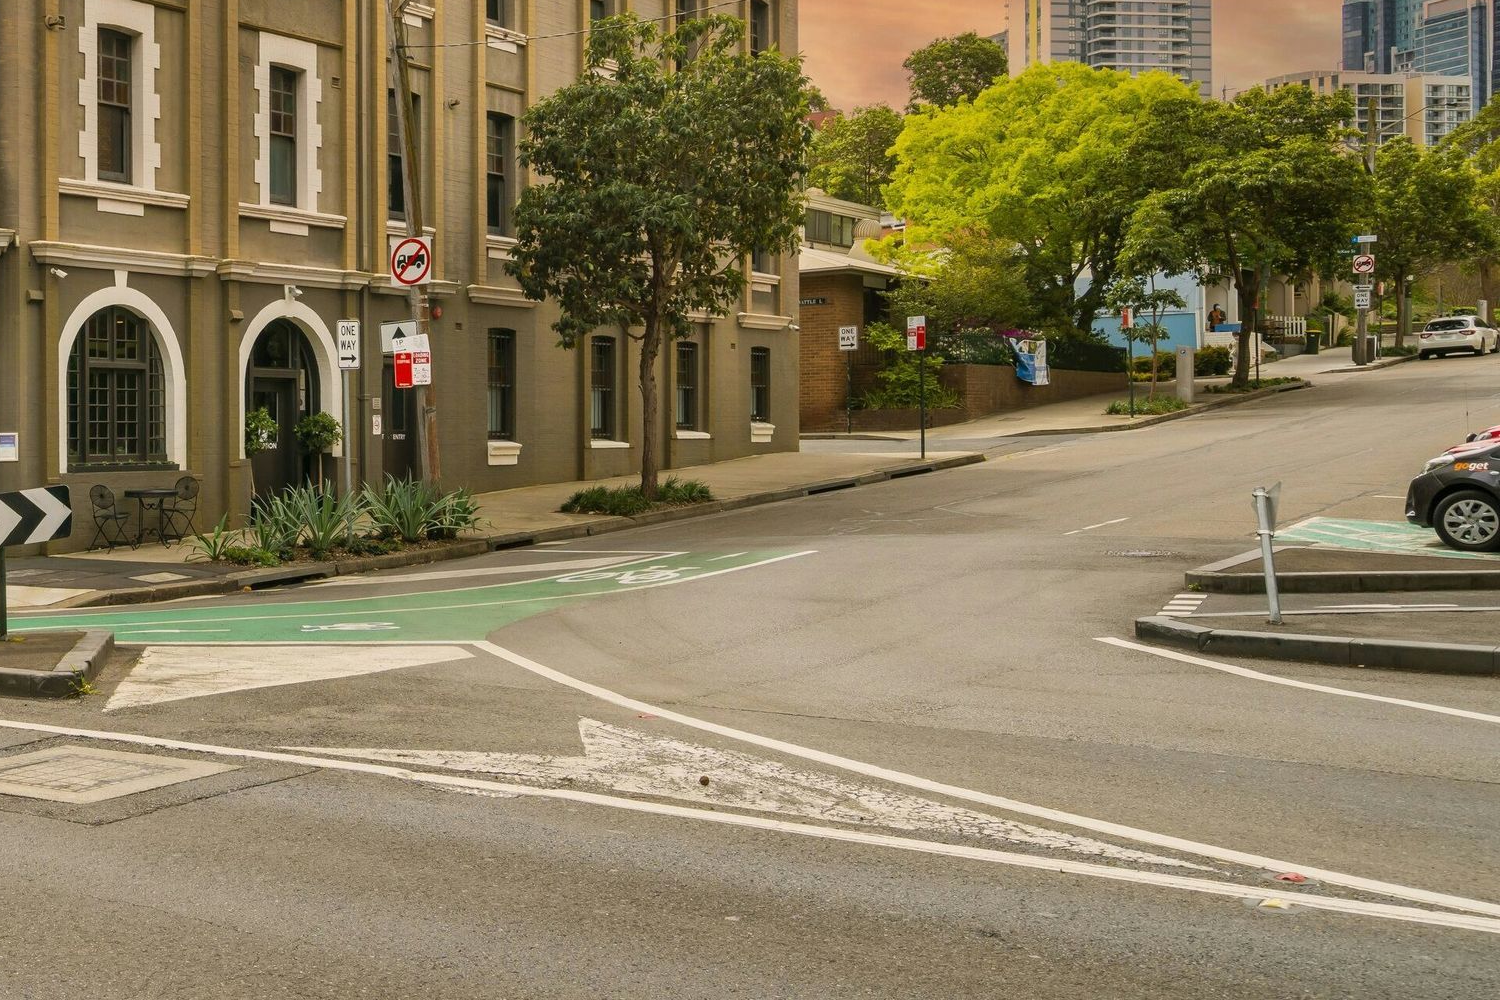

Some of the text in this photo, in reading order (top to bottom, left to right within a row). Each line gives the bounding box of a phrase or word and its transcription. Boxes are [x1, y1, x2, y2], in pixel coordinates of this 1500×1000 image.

[340, 325, 356, 336] ONE
[340, 340, 357, 350] WAY
[1454, 462, 1489, 471] goget
